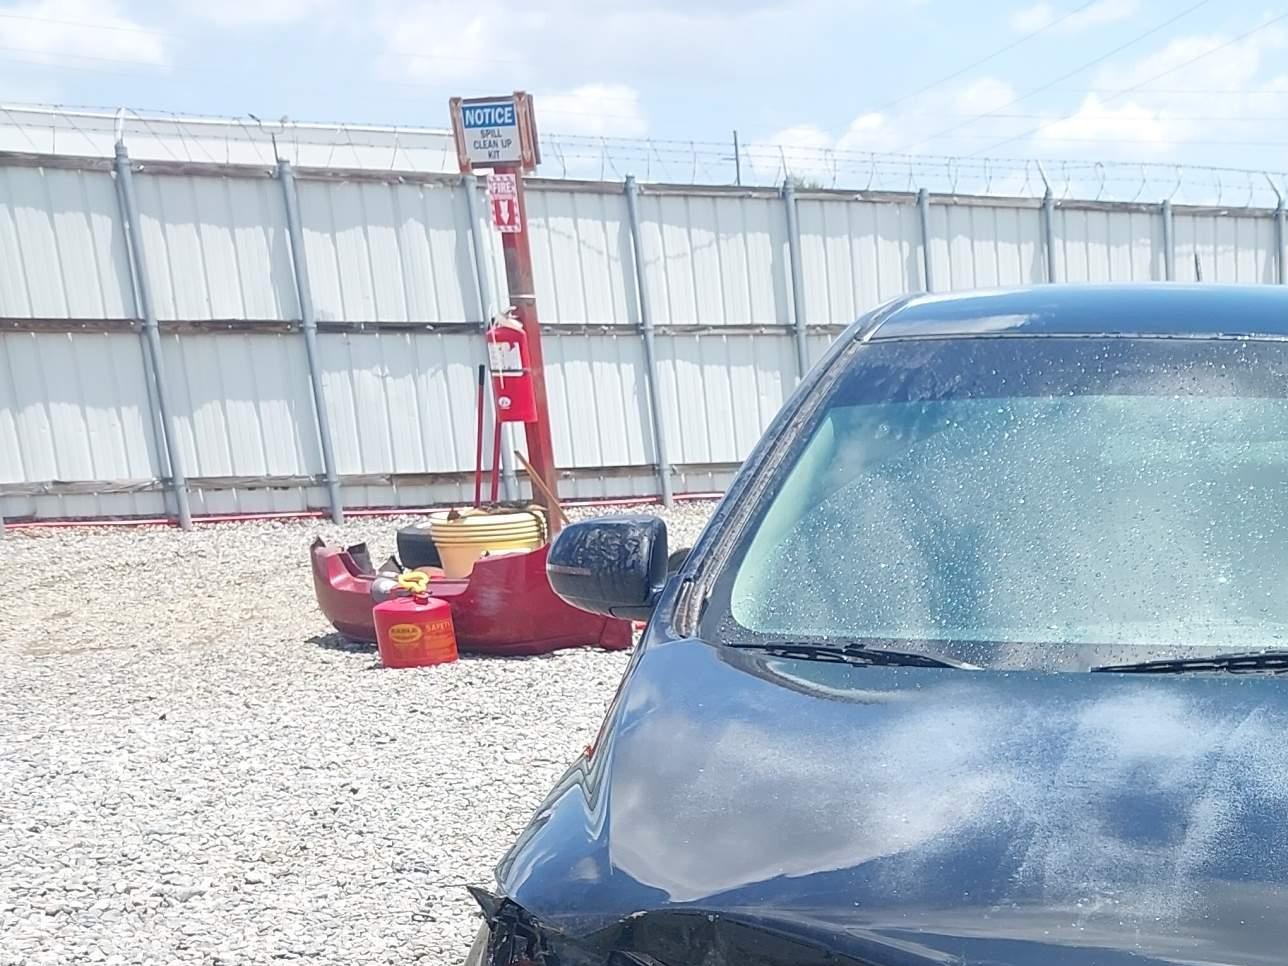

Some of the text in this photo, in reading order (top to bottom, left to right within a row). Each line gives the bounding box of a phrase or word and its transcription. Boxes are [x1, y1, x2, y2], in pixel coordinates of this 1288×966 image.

[465, 107, 512, 125] NOTICE
[480, 129, 503, 138] SPILL
[473, 139, 513, 150] CLEAN UP
[488, 150, 501, 160] KIT
[493, 182, 514, 194] FIRE
